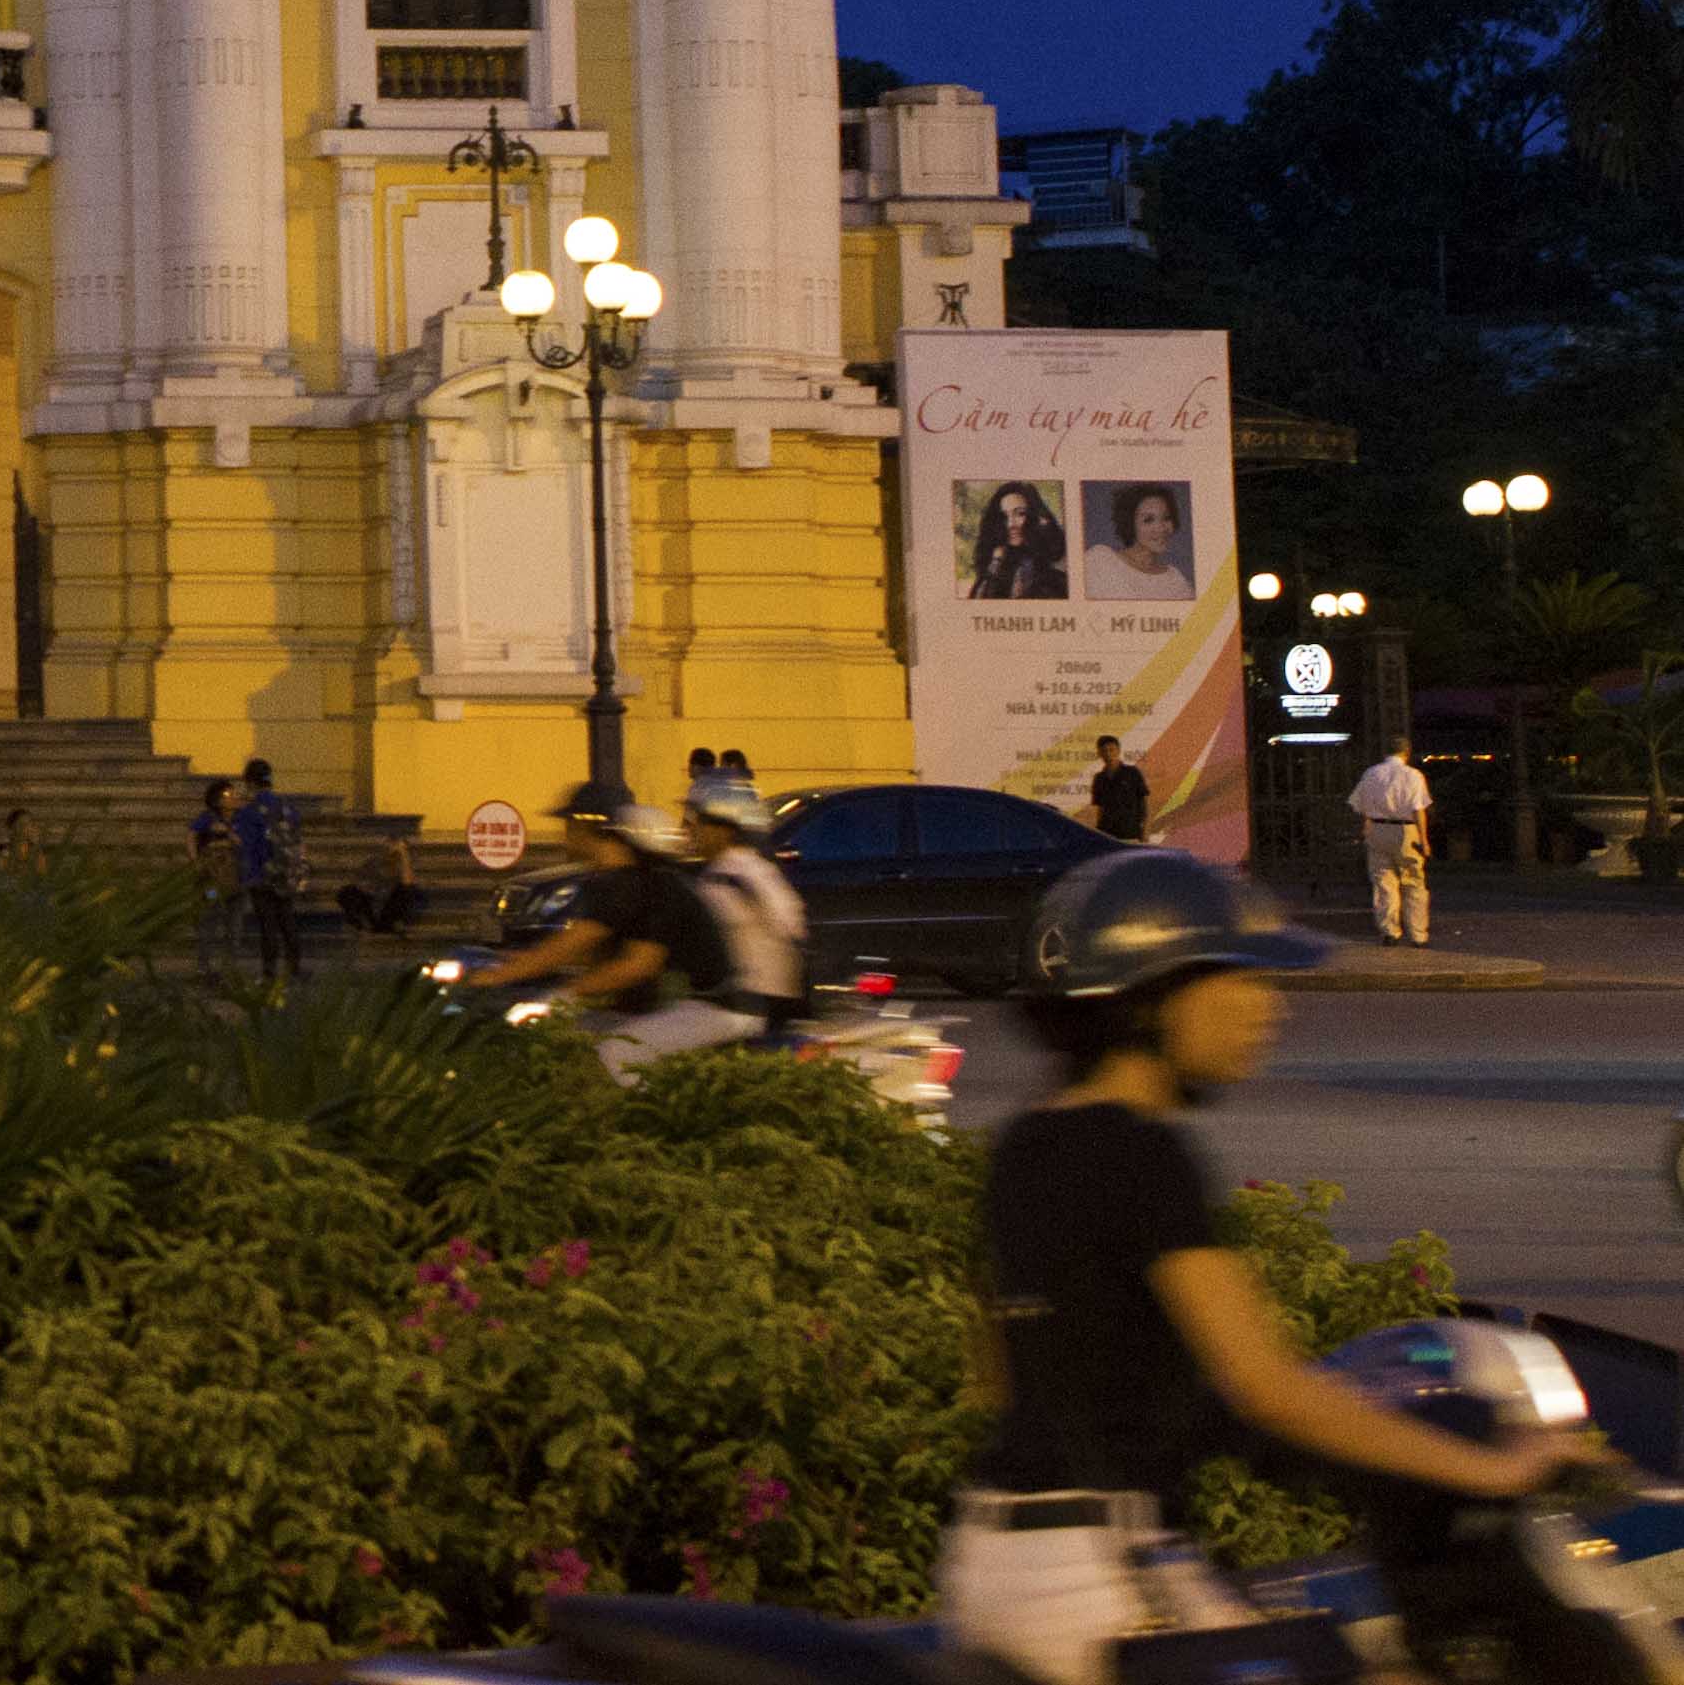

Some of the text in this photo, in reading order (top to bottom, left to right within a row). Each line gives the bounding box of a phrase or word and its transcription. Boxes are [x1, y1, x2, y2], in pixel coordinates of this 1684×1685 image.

[1027, 402, 1085, 467] tay
[1088, 401, 1153, 431] mùa
[1169, 376, 1219, 431] hè
[972, 616, 1076, 632] THANH LAM
[1140, 617, 1180, 633] LINH
